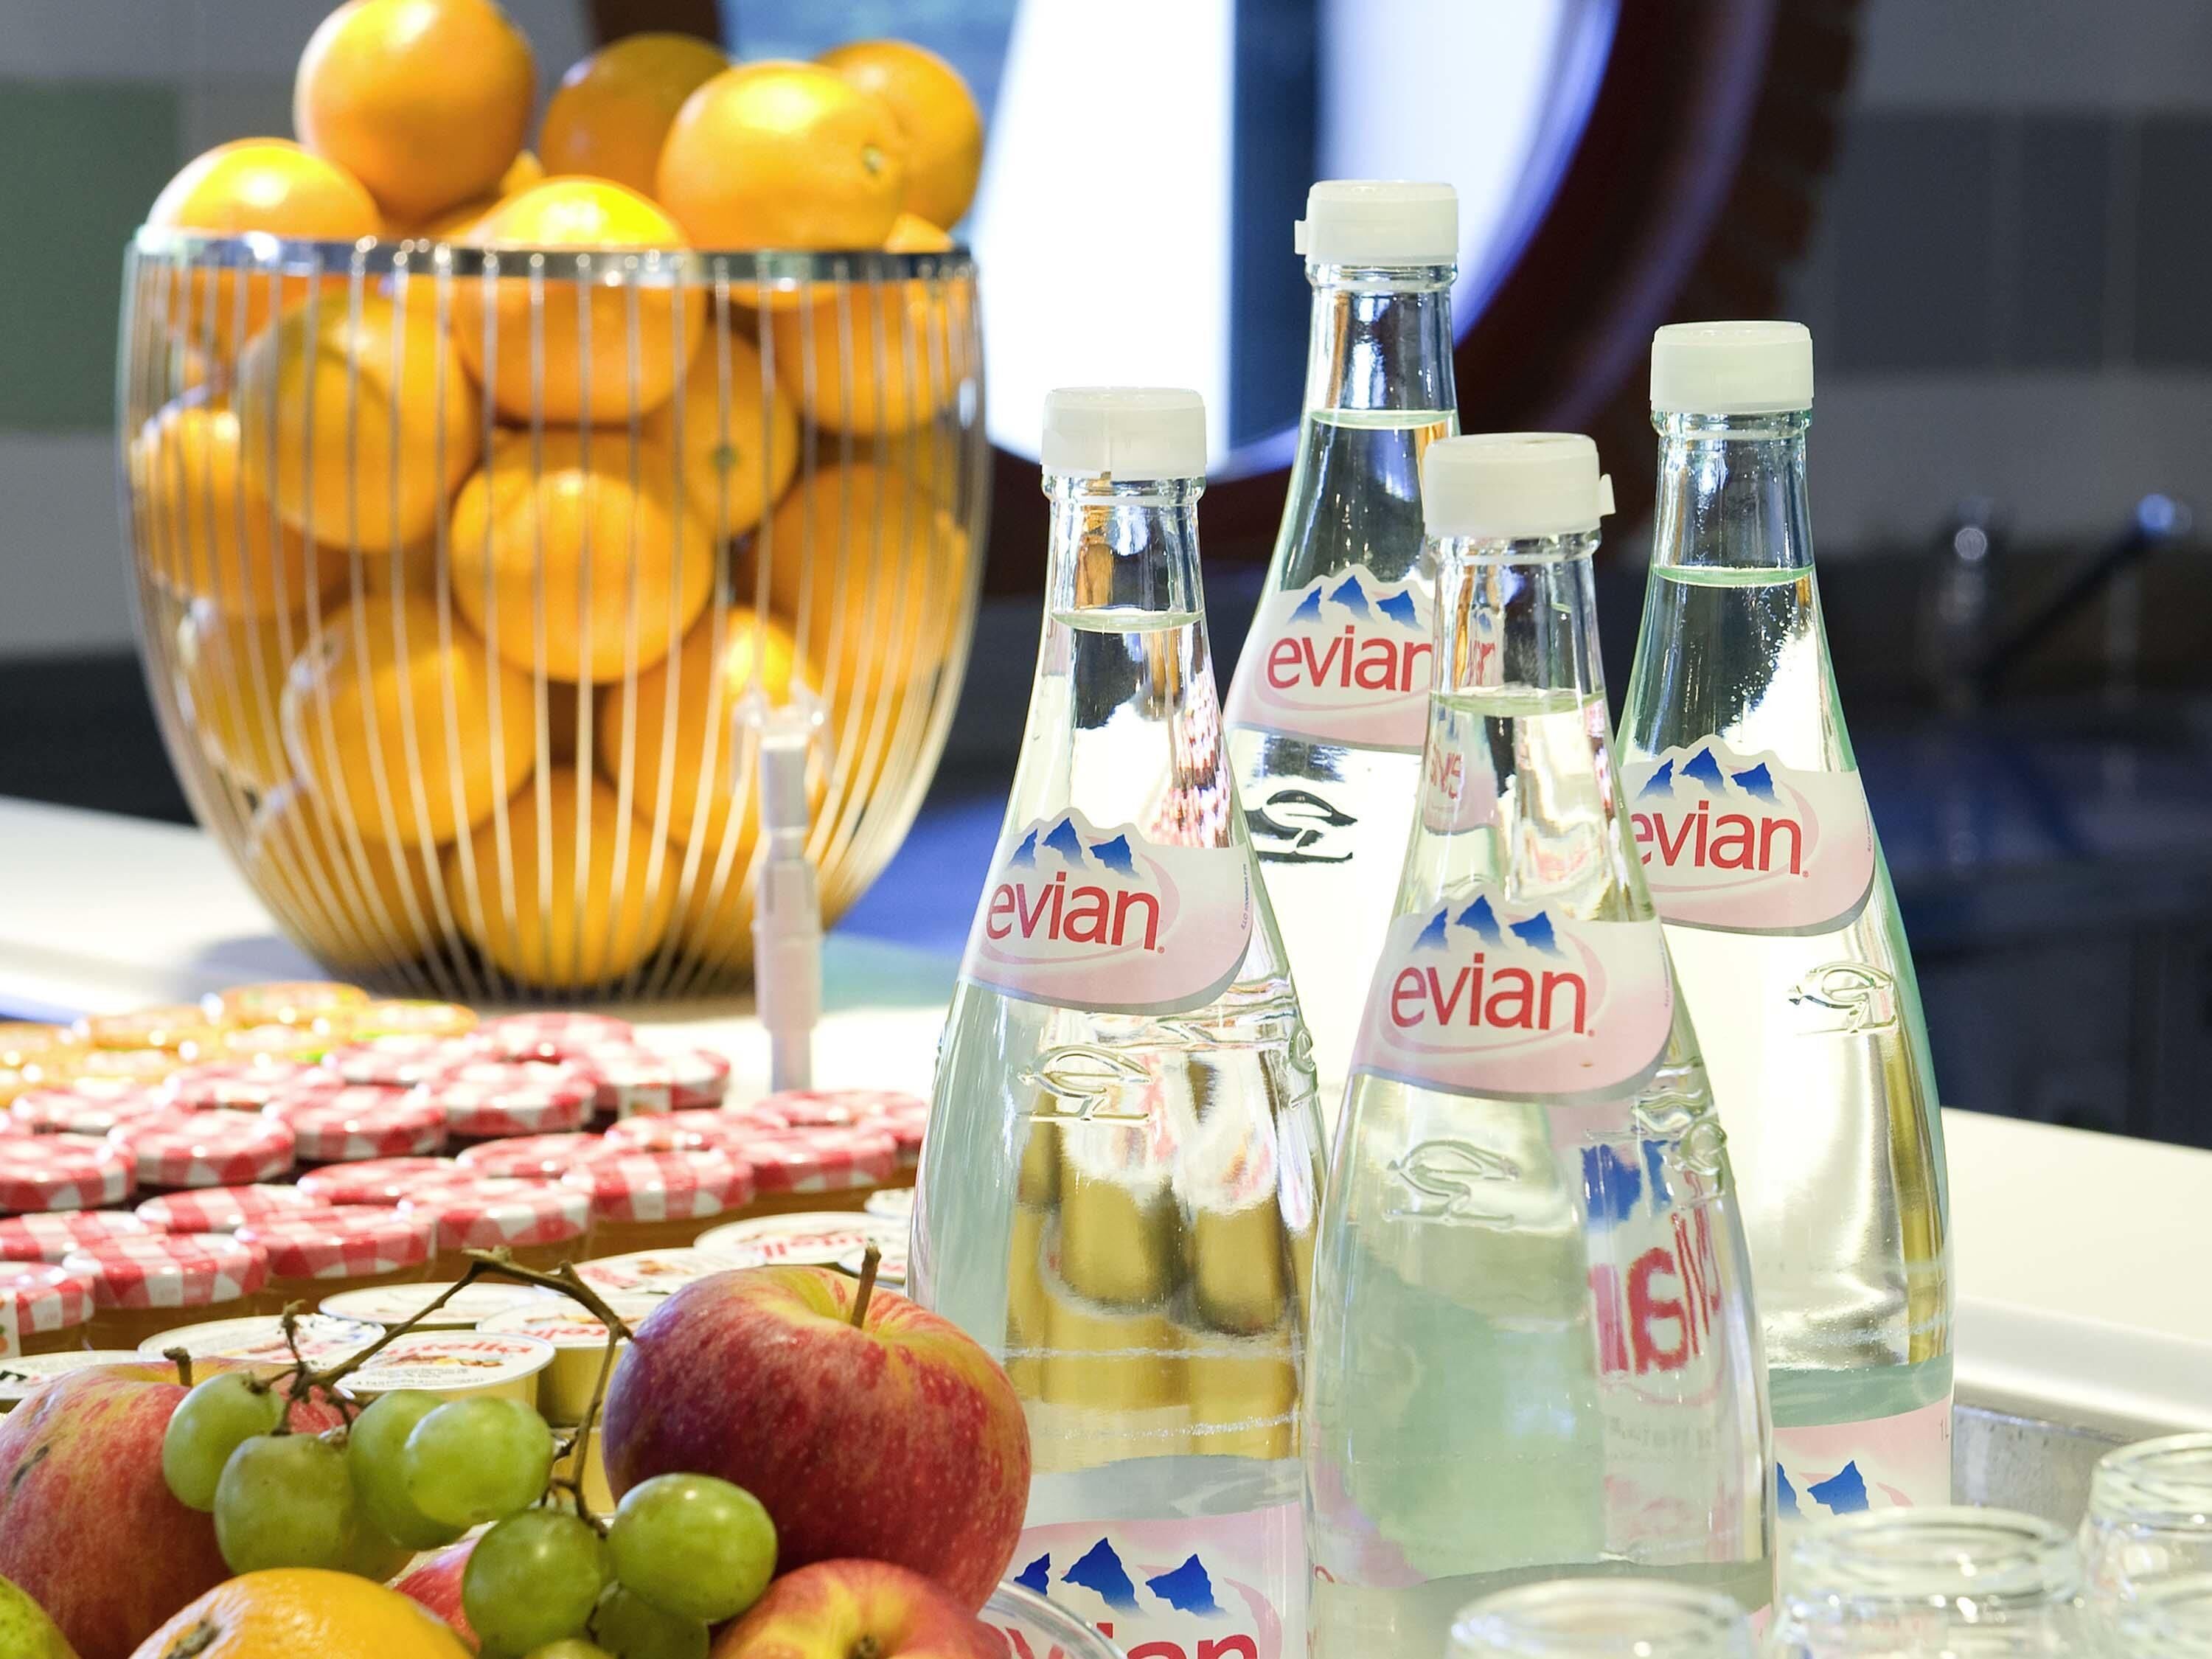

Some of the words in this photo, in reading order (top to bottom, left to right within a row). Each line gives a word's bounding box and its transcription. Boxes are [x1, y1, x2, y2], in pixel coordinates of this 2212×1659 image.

[1266, 625, 1432, 692] evian
[986, 872, 1161, 951] evian
[1391, 952, 1587, 1035] evian
